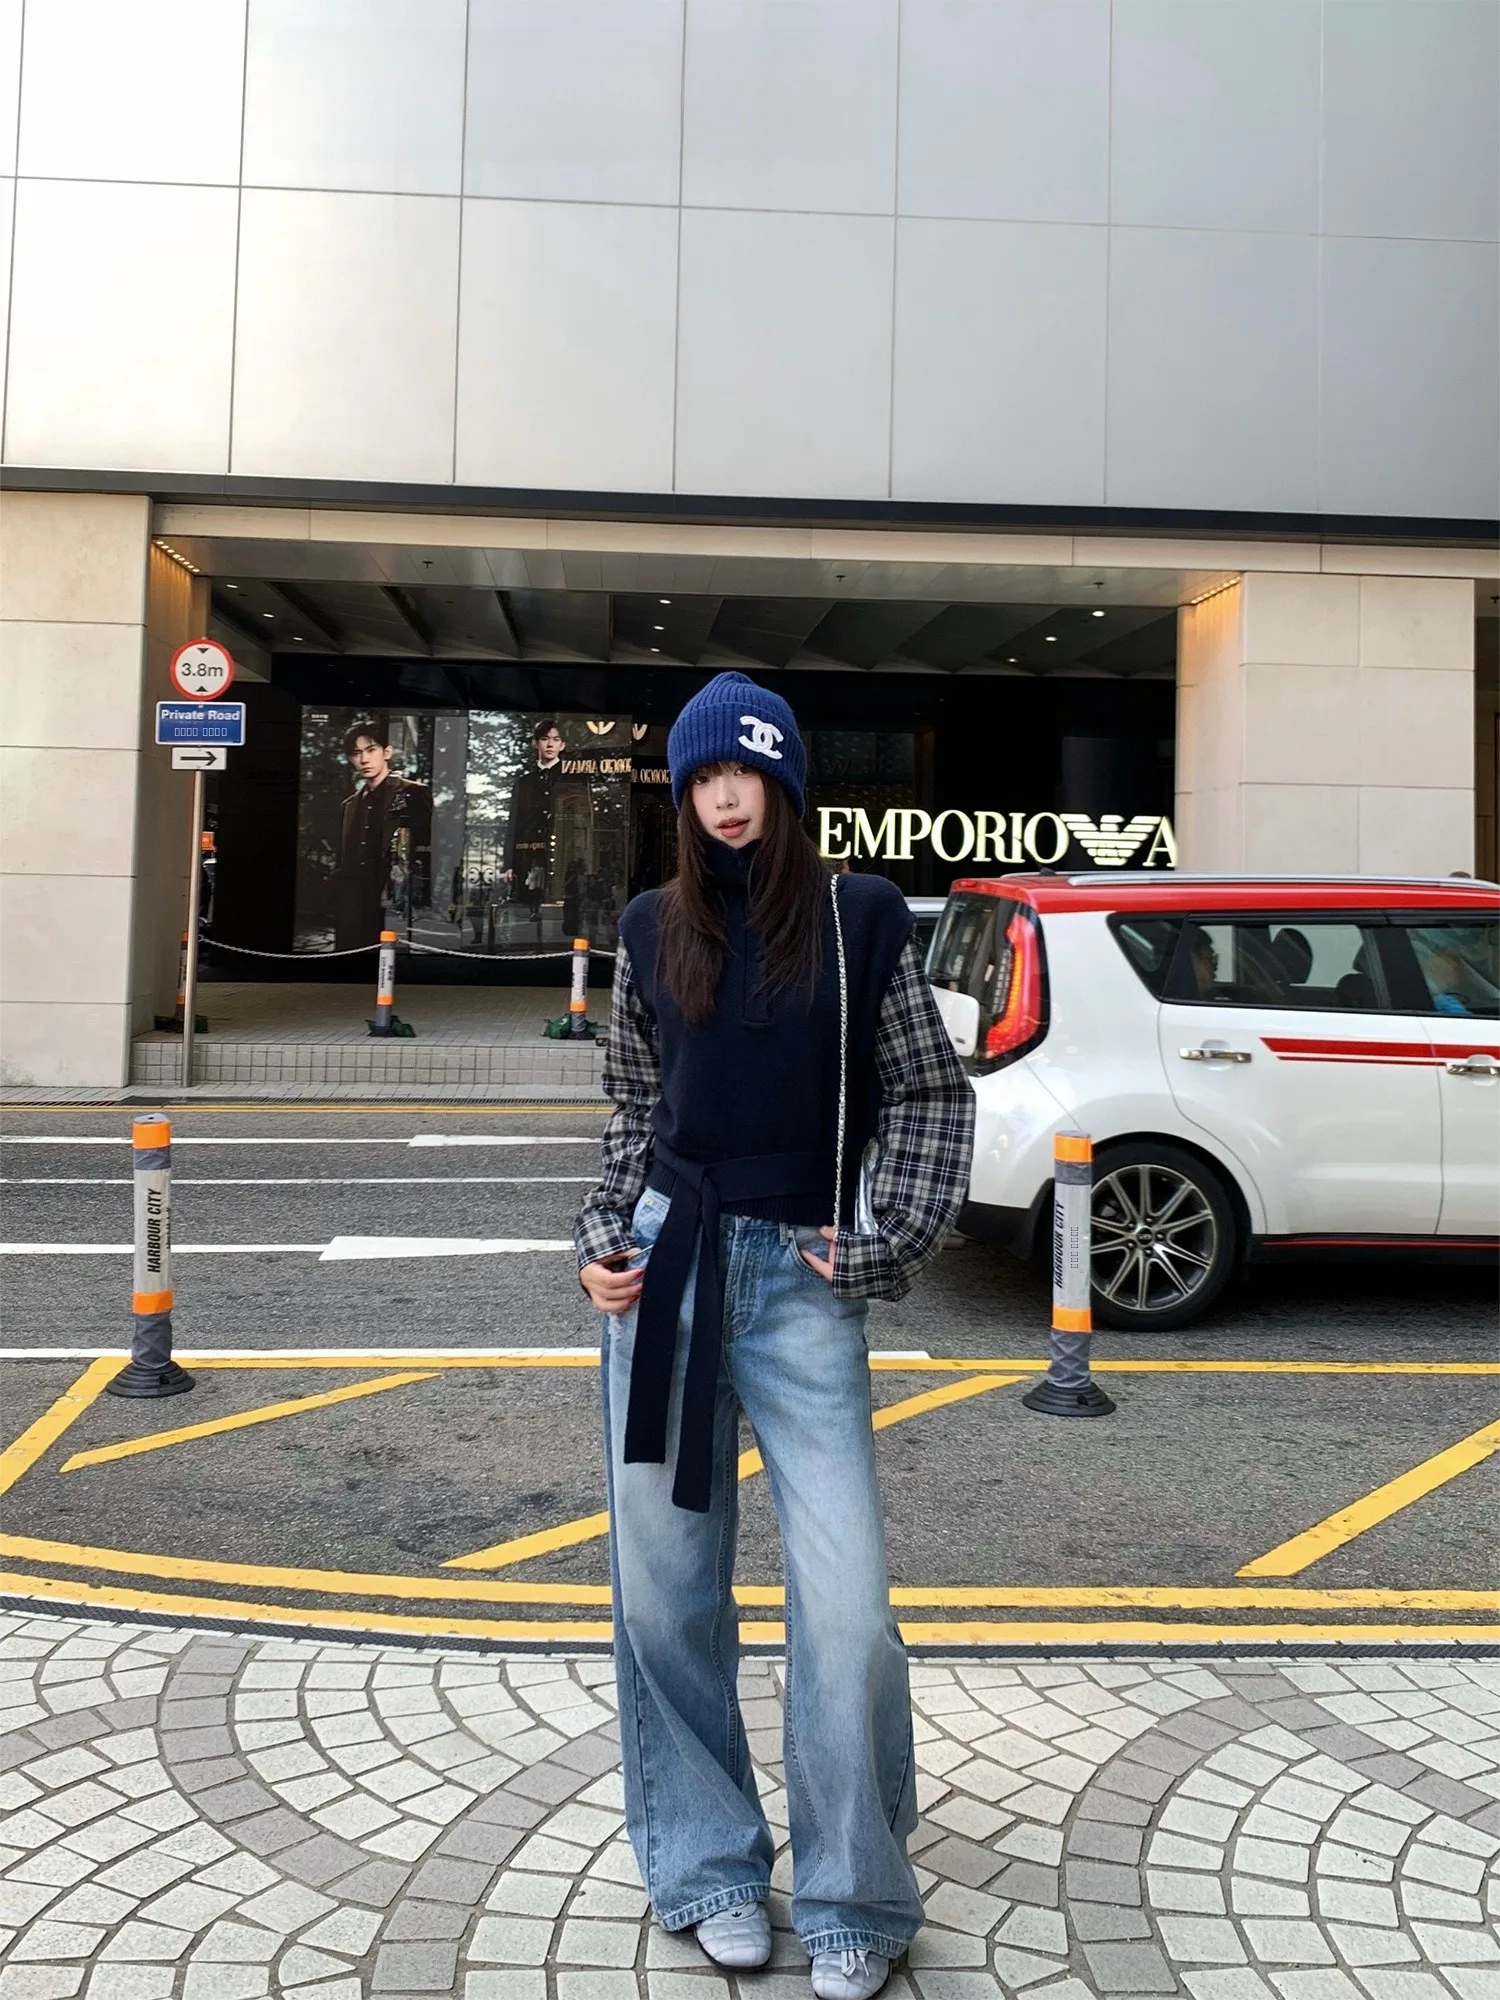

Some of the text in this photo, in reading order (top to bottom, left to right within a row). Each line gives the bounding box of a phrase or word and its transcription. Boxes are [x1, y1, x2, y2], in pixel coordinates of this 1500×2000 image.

[181, 662, 223, 677] 3.8m
[161, 709, 240, 721] Private Road
[817, 806, 1069, 864] EMPORIO
[147, 1188, 162, 1273] HARBOUR CITY
